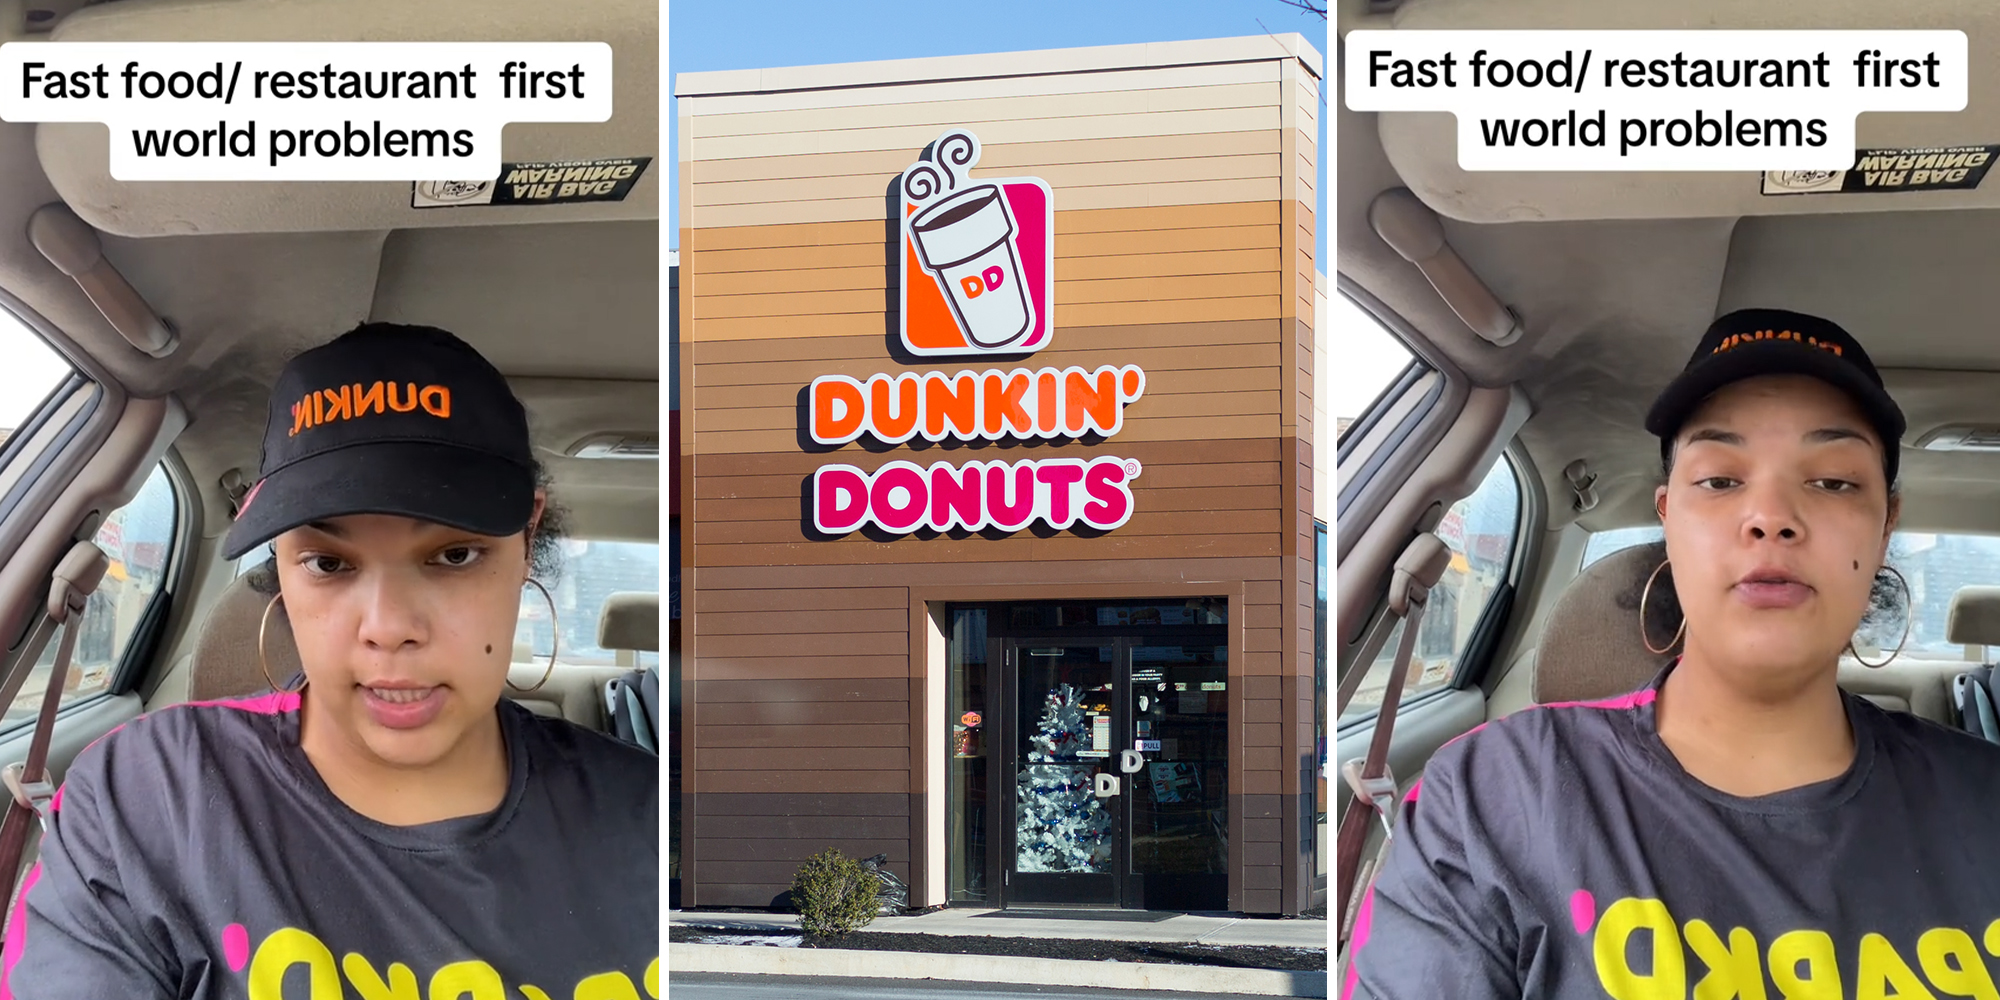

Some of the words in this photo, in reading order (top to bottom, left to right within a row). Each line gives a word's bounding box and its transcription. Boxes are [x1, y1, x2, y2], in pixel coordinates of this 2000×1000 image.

[959, 265, 1005, 300] DD
[815, 370, 1140, 439] DUNKIN'
[818, 462, 1128, 528] DONUTS
[1143, 742, 1160, 750] PULL
[1121, 749, 1144, 773] D
[1095, 773, 1117, 797] D
